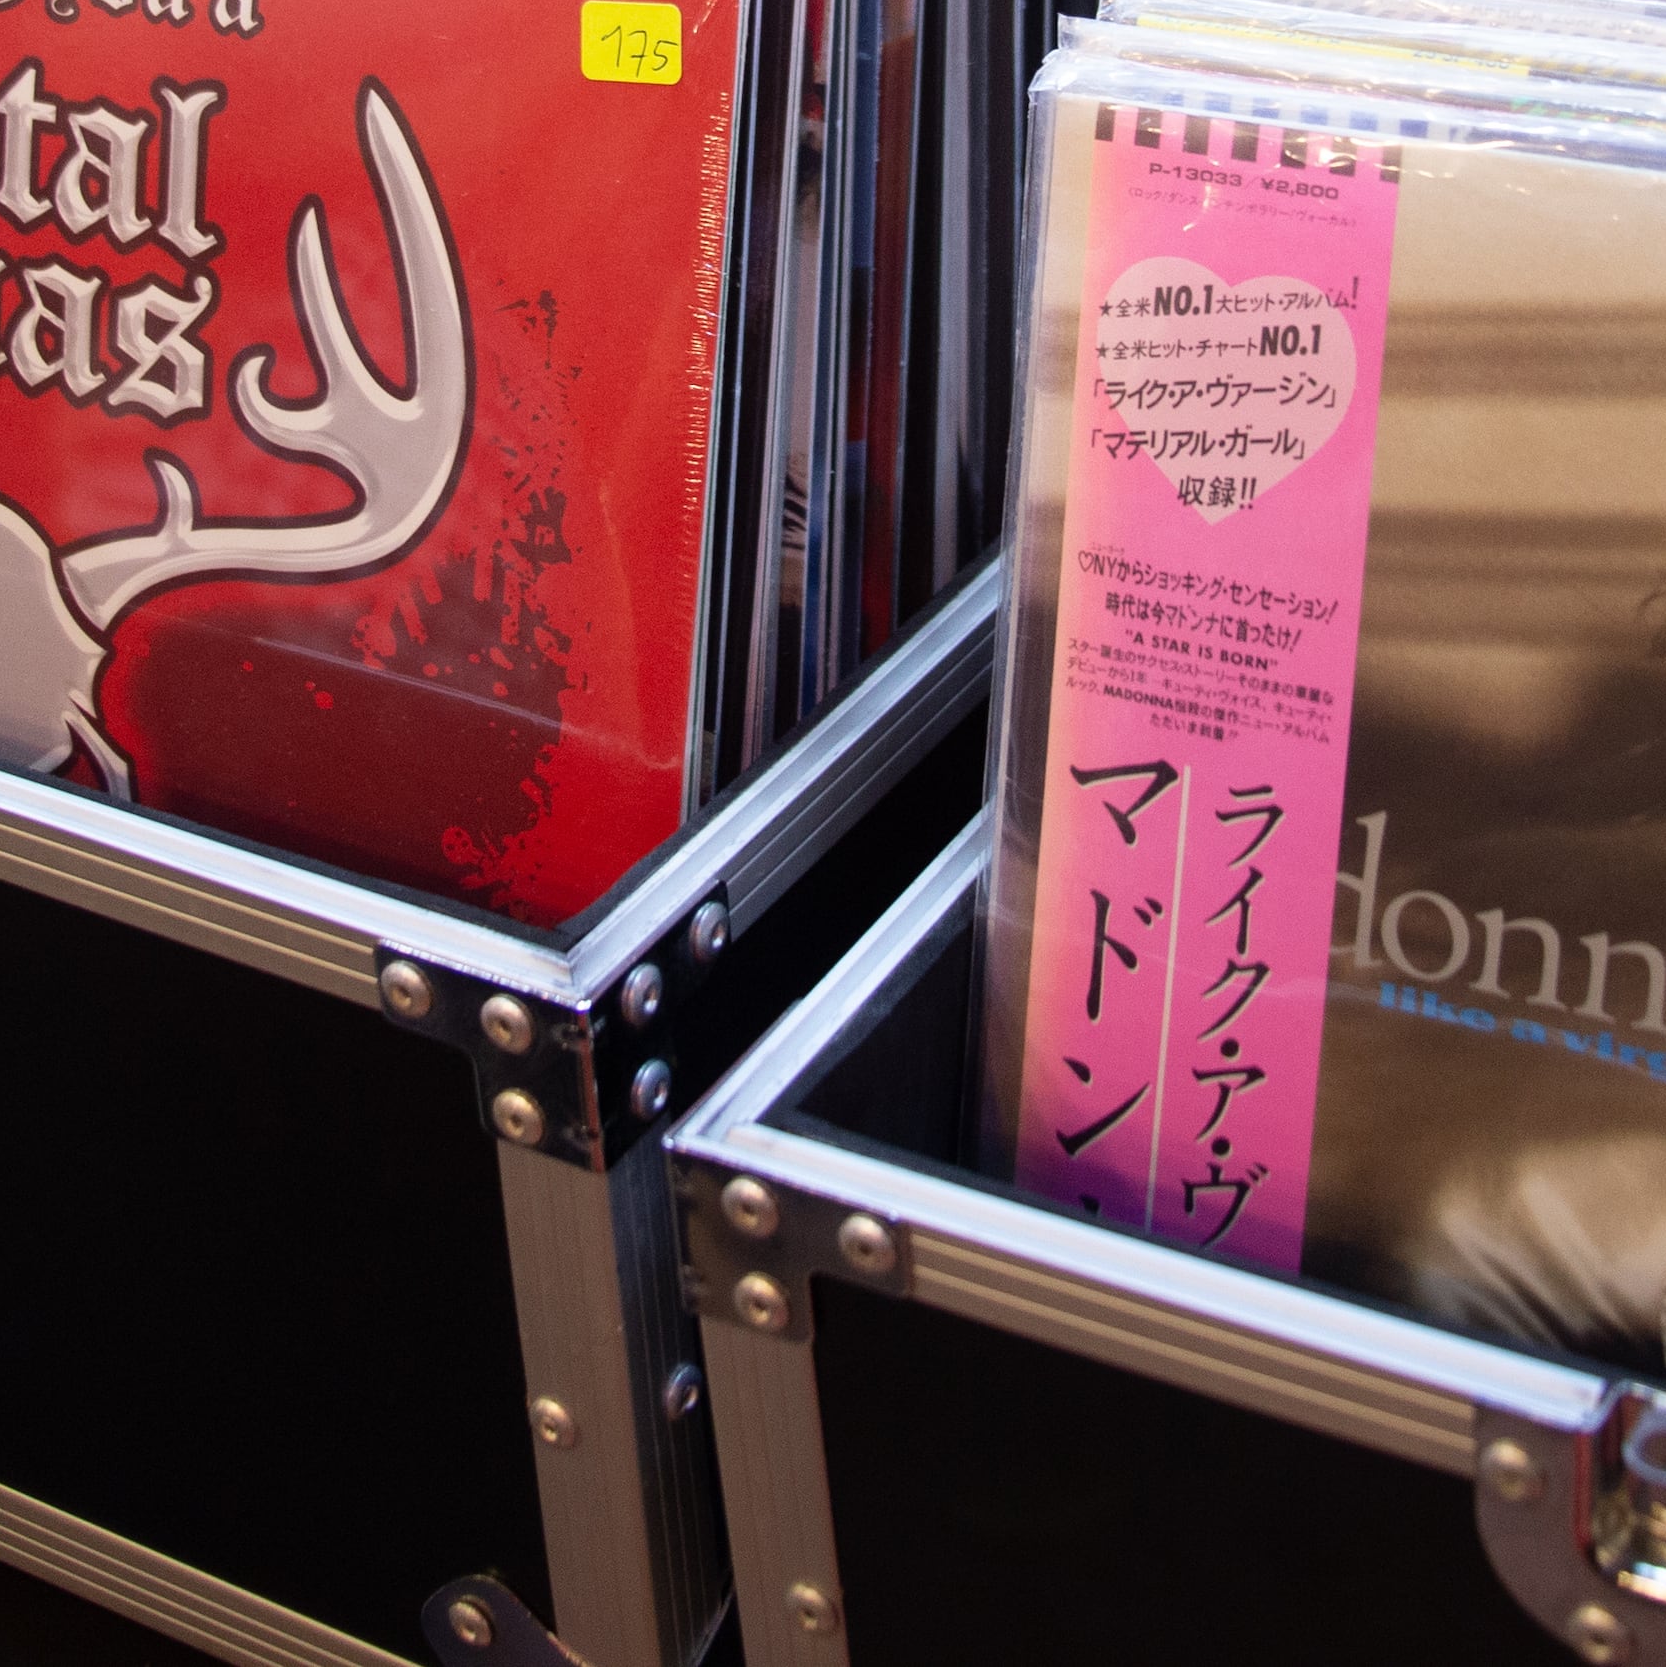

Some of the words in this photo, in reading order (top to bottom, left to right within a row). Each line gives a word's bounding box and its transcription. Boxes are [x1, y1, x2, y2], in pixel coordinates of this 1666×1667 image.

[601, 24, 679, 78] 175
[1151, 635, 1191, 654] STAR
[1198, 644, 1213, 660] IS
[1055, 756, 1180, 1220] マドン
[1378, 980, 1497, 1032] like
[1510, 1017, 1547, 1044] a
